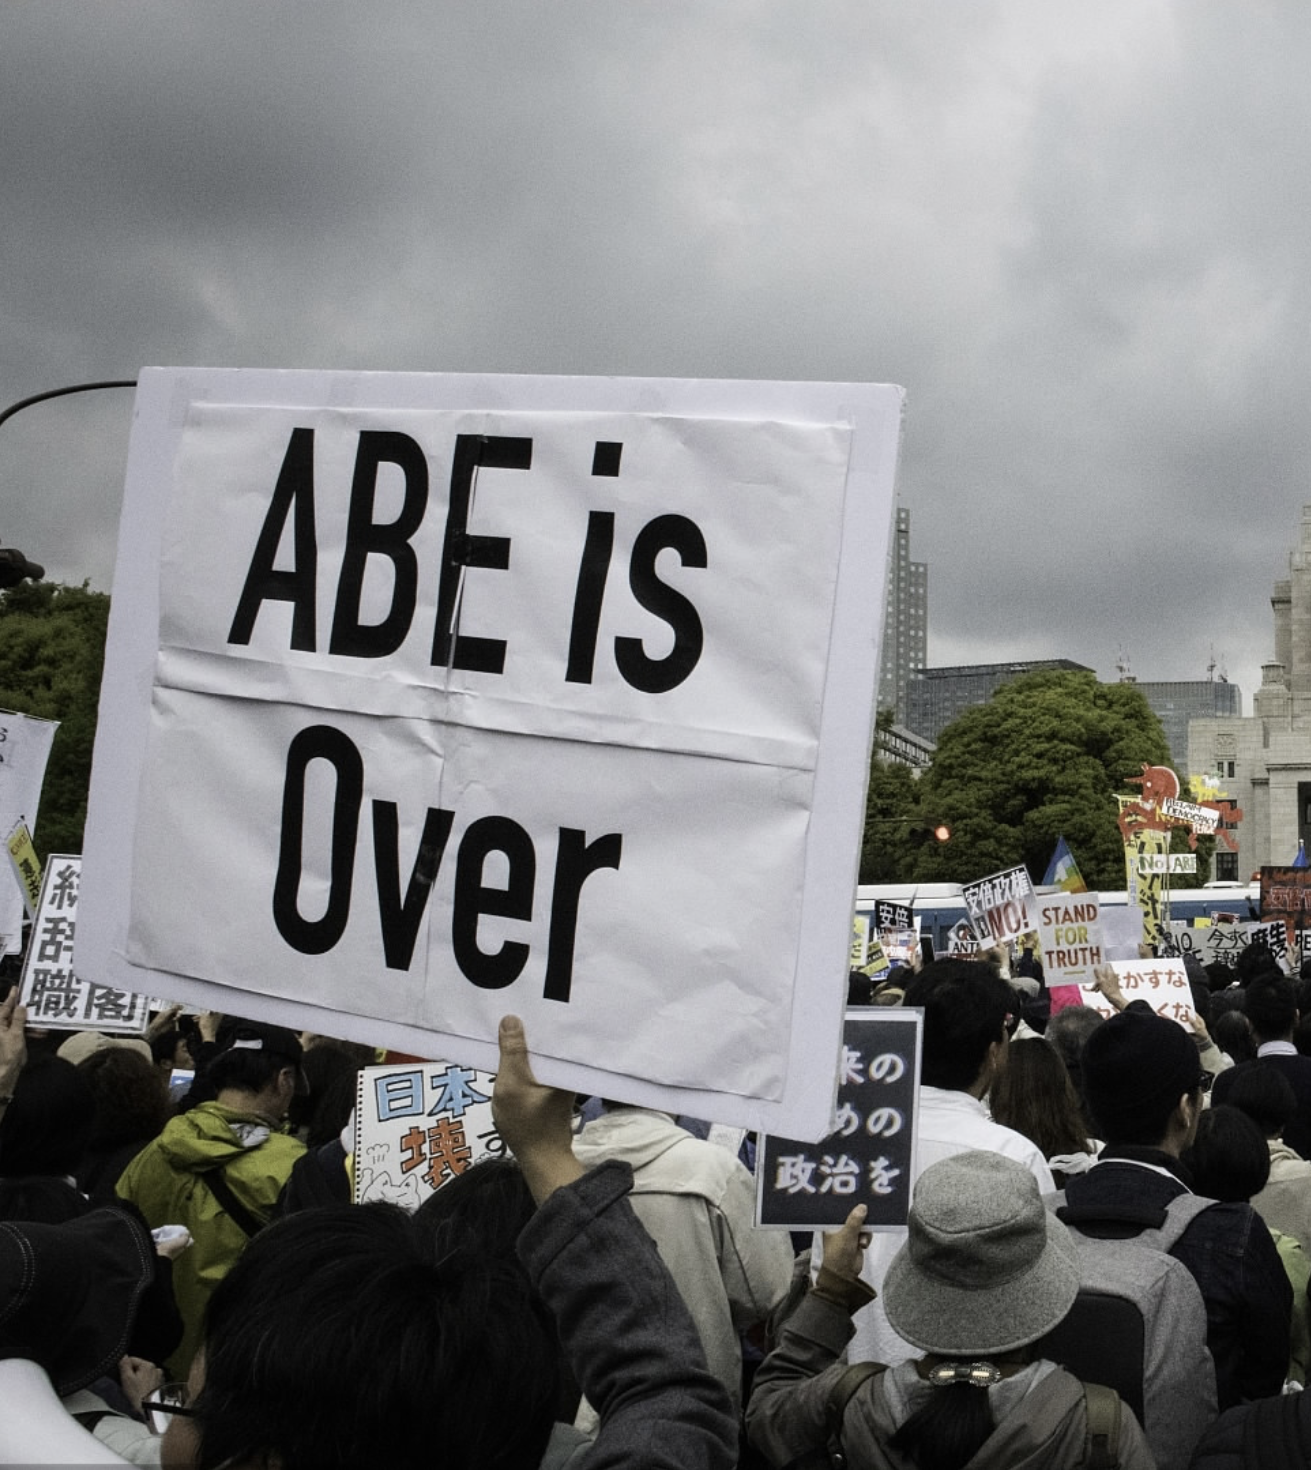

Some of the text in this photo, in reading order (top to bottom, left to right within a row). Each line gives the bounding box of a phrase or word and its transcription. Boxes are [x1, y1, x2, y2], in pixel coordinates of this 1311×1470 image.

[227, 427, 709, 694] ABE is
[272, 723, 623, 1003] Over
[965, 870, 1031, 916] 安倍政権
[879, 903, 909, 929] 安倍
[987, 901, 1029, 942] NO!
[1042, 903, 1098, 926] STAND
[1055, 925, 1089, 946] FOR
[1045, 946, 1100, 969] TRUTH
[374, 1064, 497, 1123] 日本
[774, 1154, 901, 1195] 政治を
